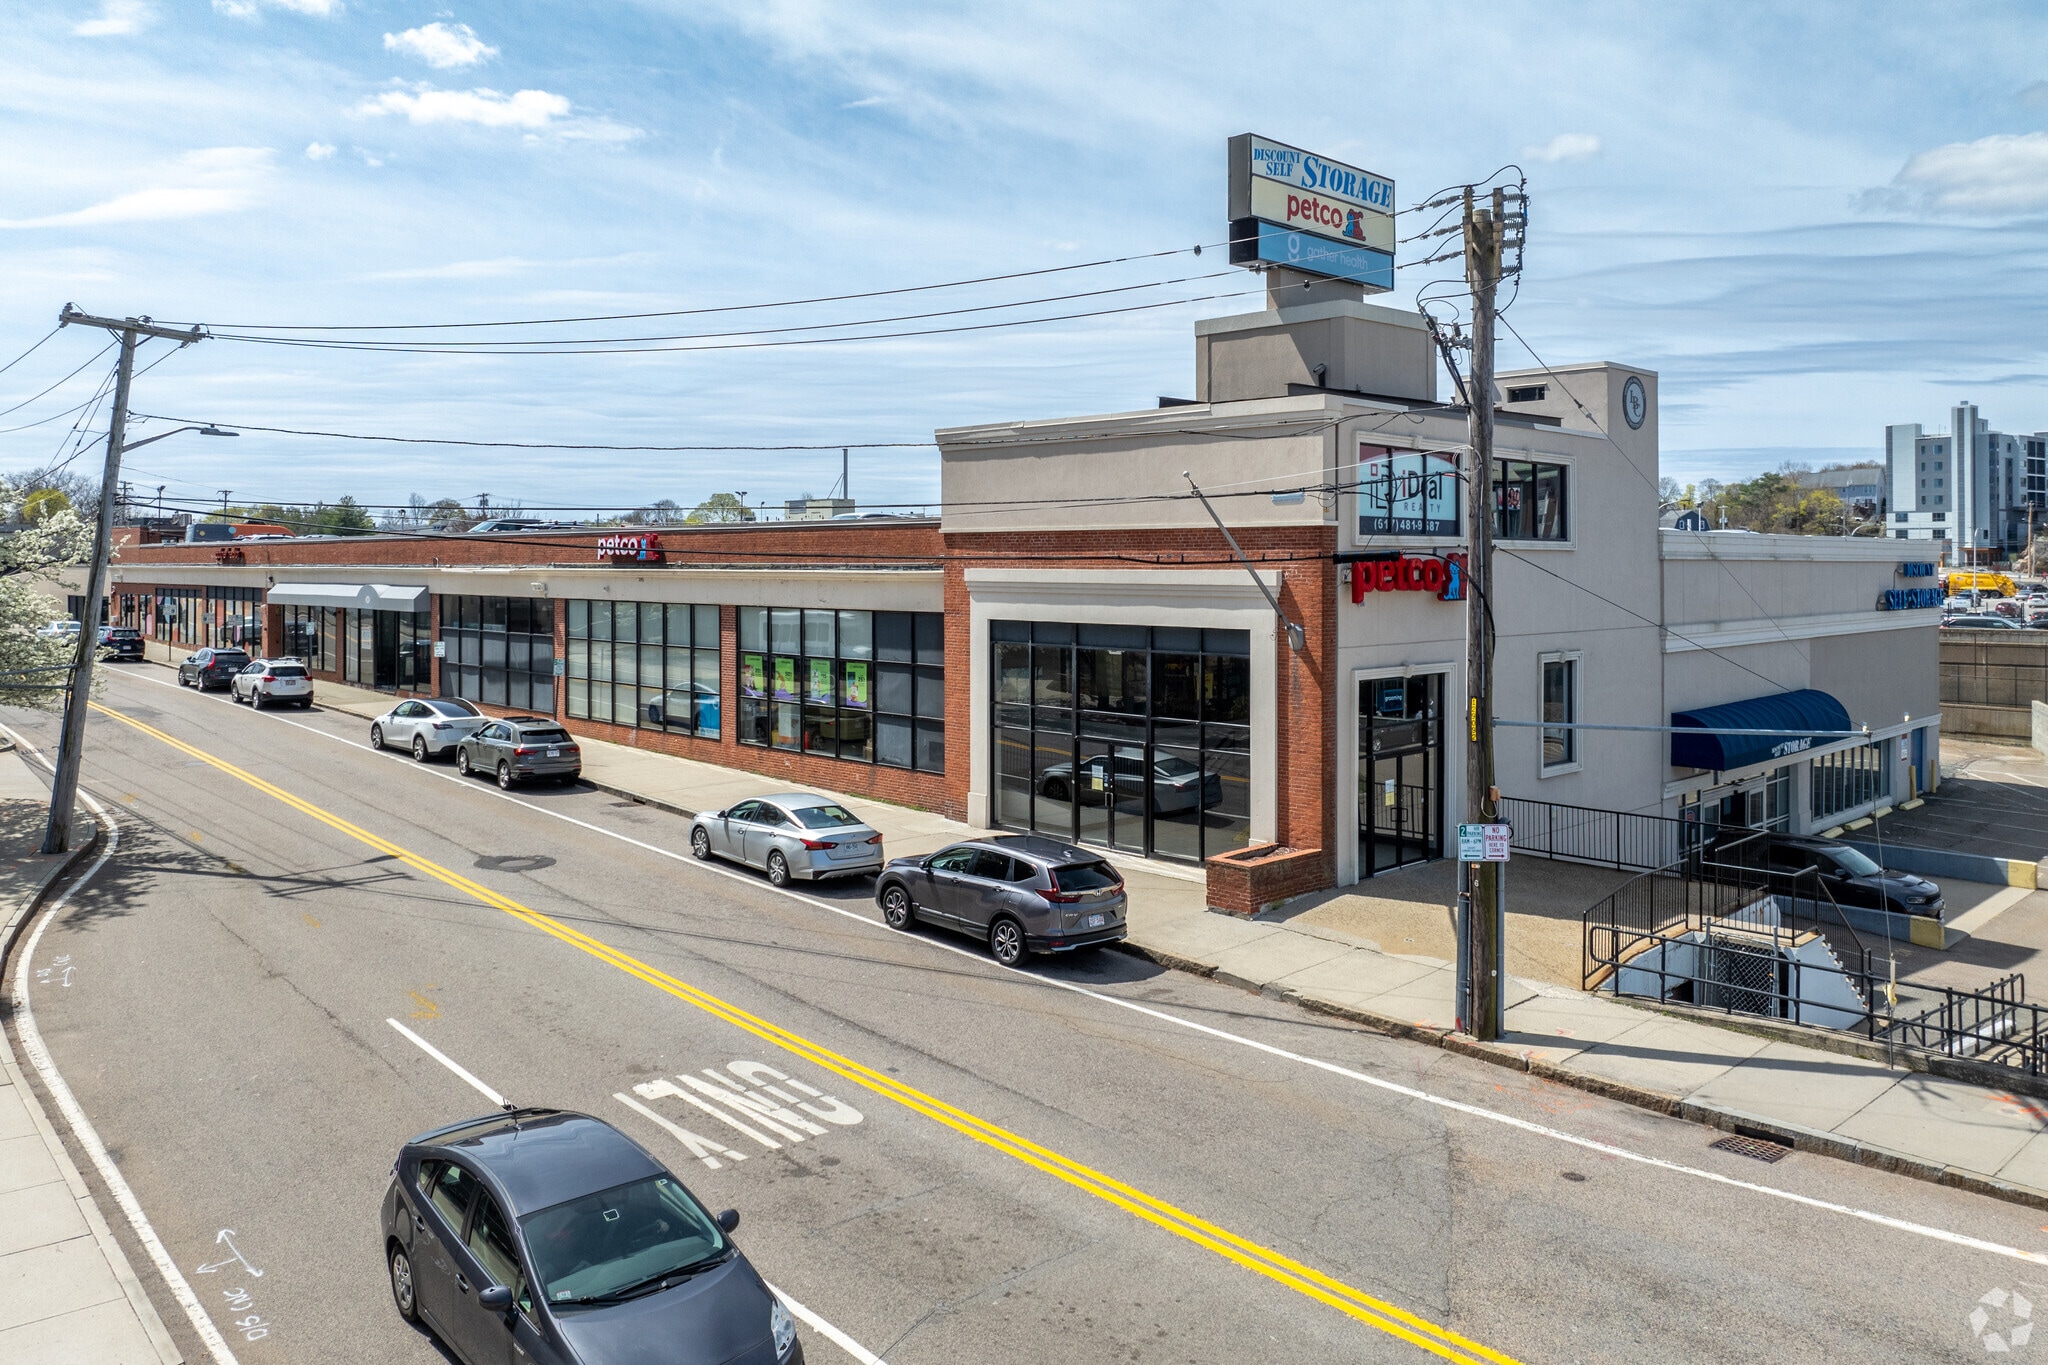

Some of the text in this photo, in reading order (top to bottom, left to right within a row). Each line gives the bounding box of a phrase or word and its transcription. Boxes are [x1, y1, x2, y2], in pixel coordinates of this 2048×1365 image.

[1253, 148, 1302, 164] DISCOUNT
[1265, 162, 1294, 177] SELF
[1301, 155, 1393, 209] STORAGE
[1286, 194, 1344, 229] petco
[1340, 252, 1368, 271] health
[1402, 470, 1443, 501] iDal
[1404, 502, 1441, 513] REATY
[597, 534, 638, 560] petco
[1351, 553, 1443, 604] petco
[1460, 826, 1466, 837] 2
[611, 1060, 864, 1170] ONLY
